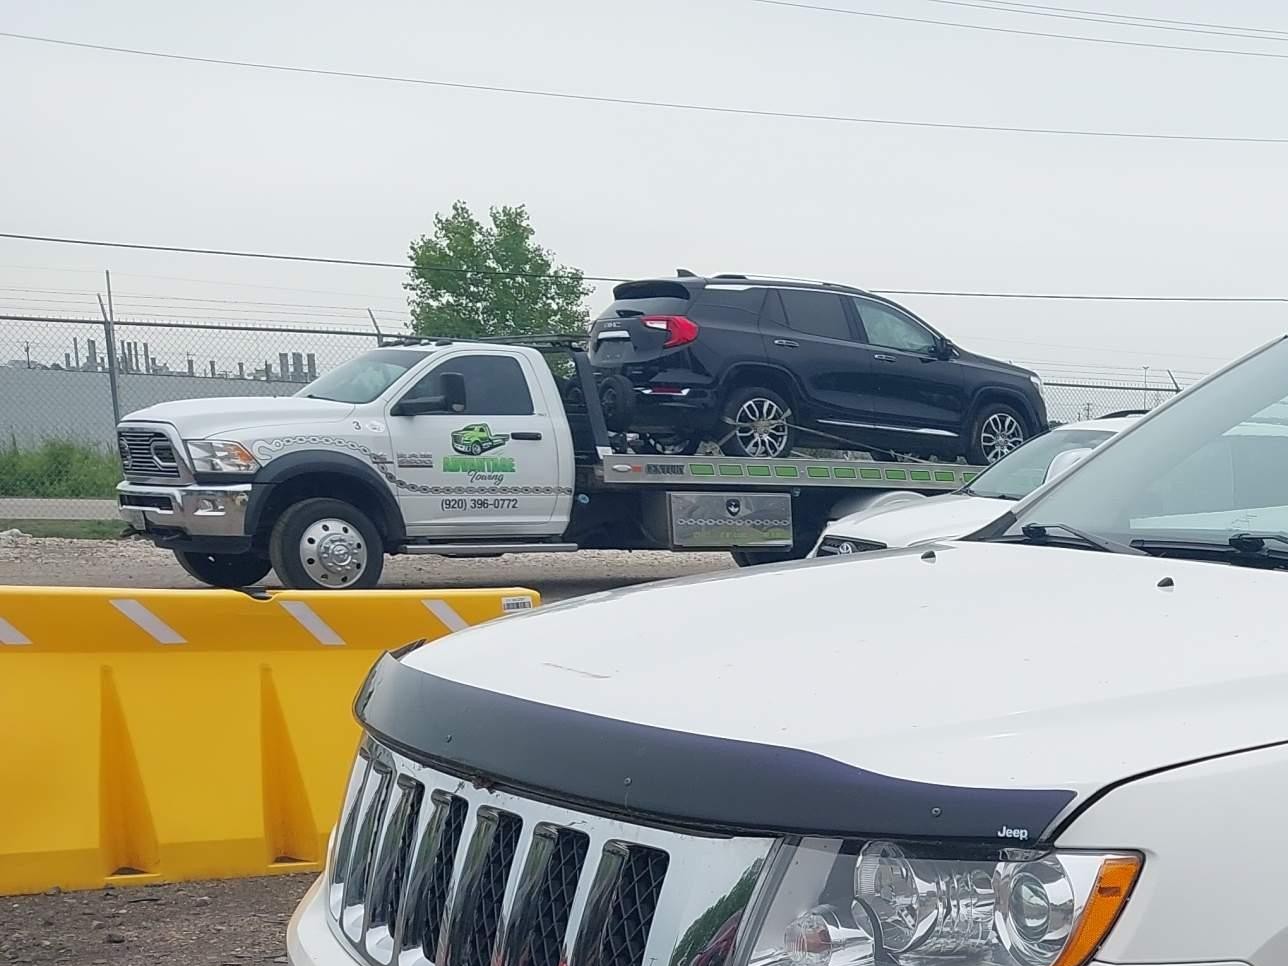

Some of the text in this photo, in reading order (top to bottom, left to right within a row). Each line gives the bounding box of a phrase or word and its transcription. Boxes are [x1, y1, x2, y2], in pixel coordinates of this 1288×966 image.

[352, 420, 361, 431] 3
[467, 470, 504, 485] Towing
[441, 499, 518, 511] (920) 396-0772
[997, 825, 1028, 840] Jeep
